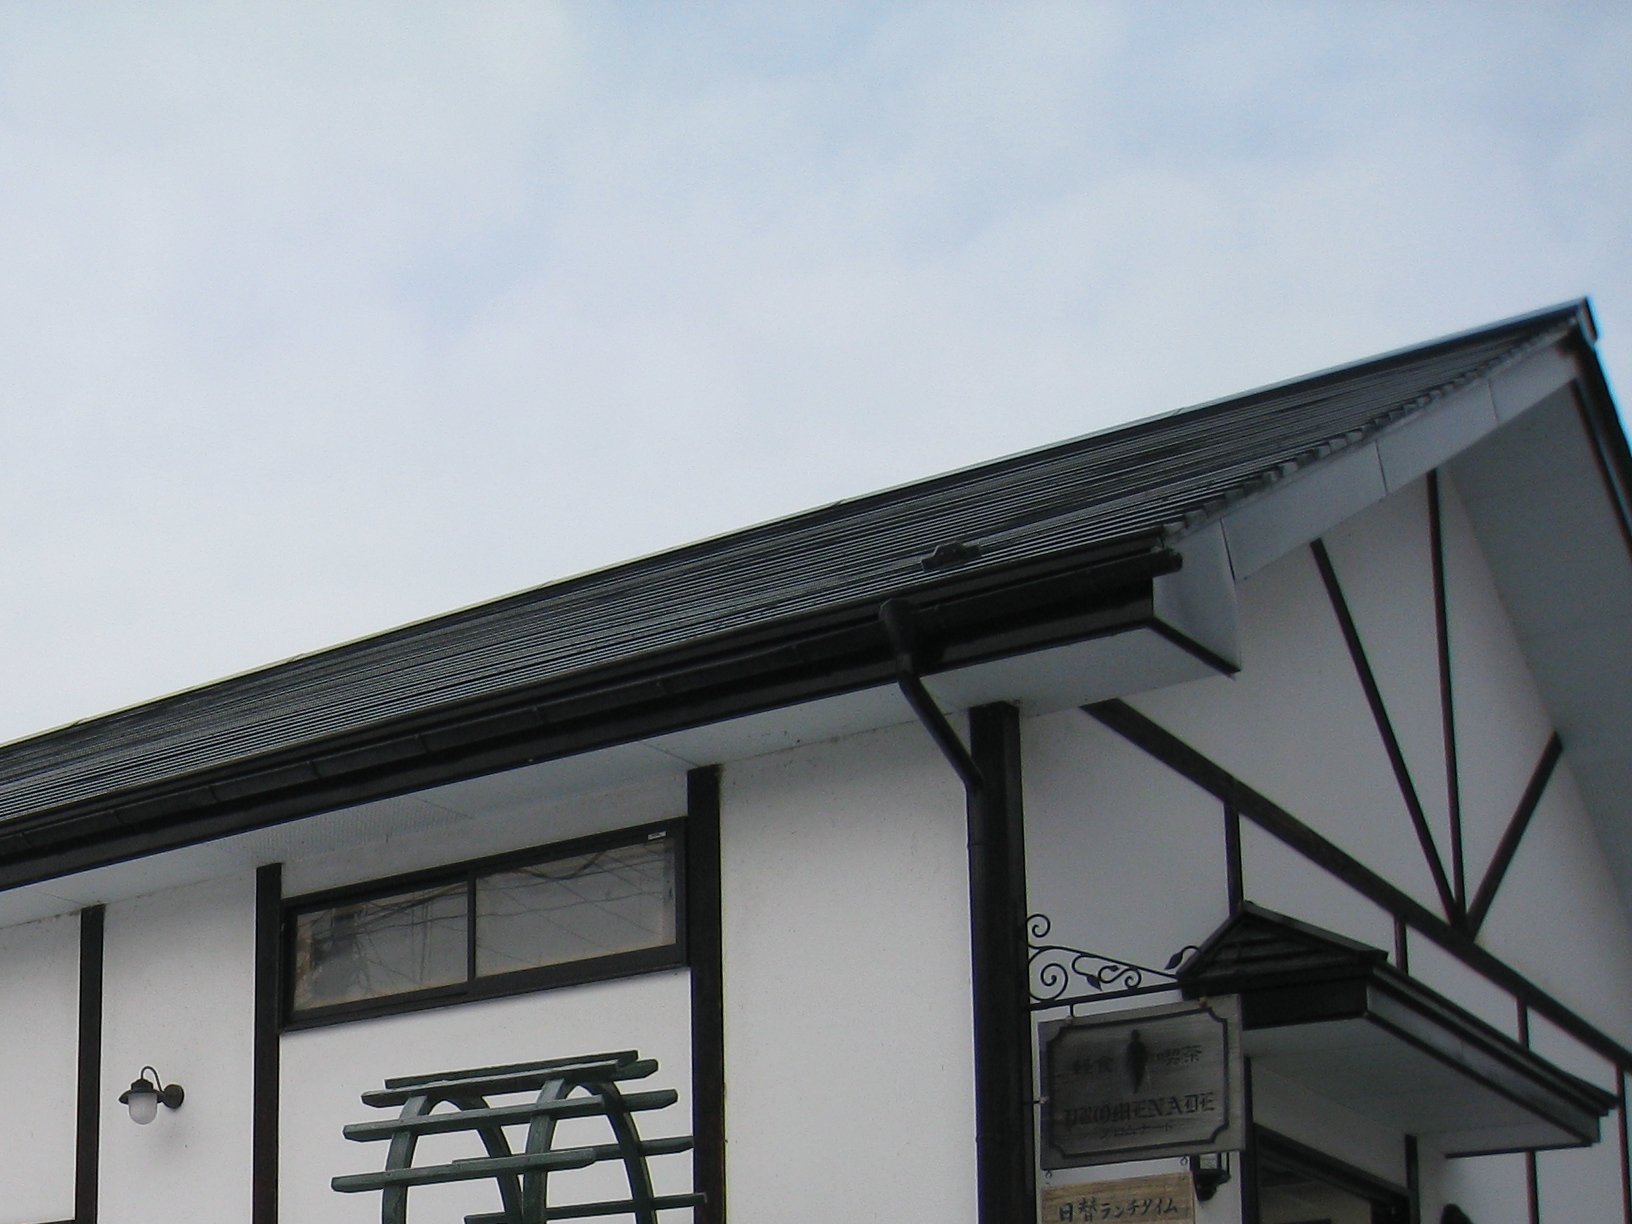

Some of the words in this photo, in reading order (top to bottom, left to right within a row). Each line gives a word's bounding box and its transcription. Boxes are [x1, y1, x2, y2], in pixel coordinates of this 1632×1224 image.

[1064, 1092, 1215, 1126] PROMENADE
[1059, 1196, 1178, 1222] 日替ランチタイム
